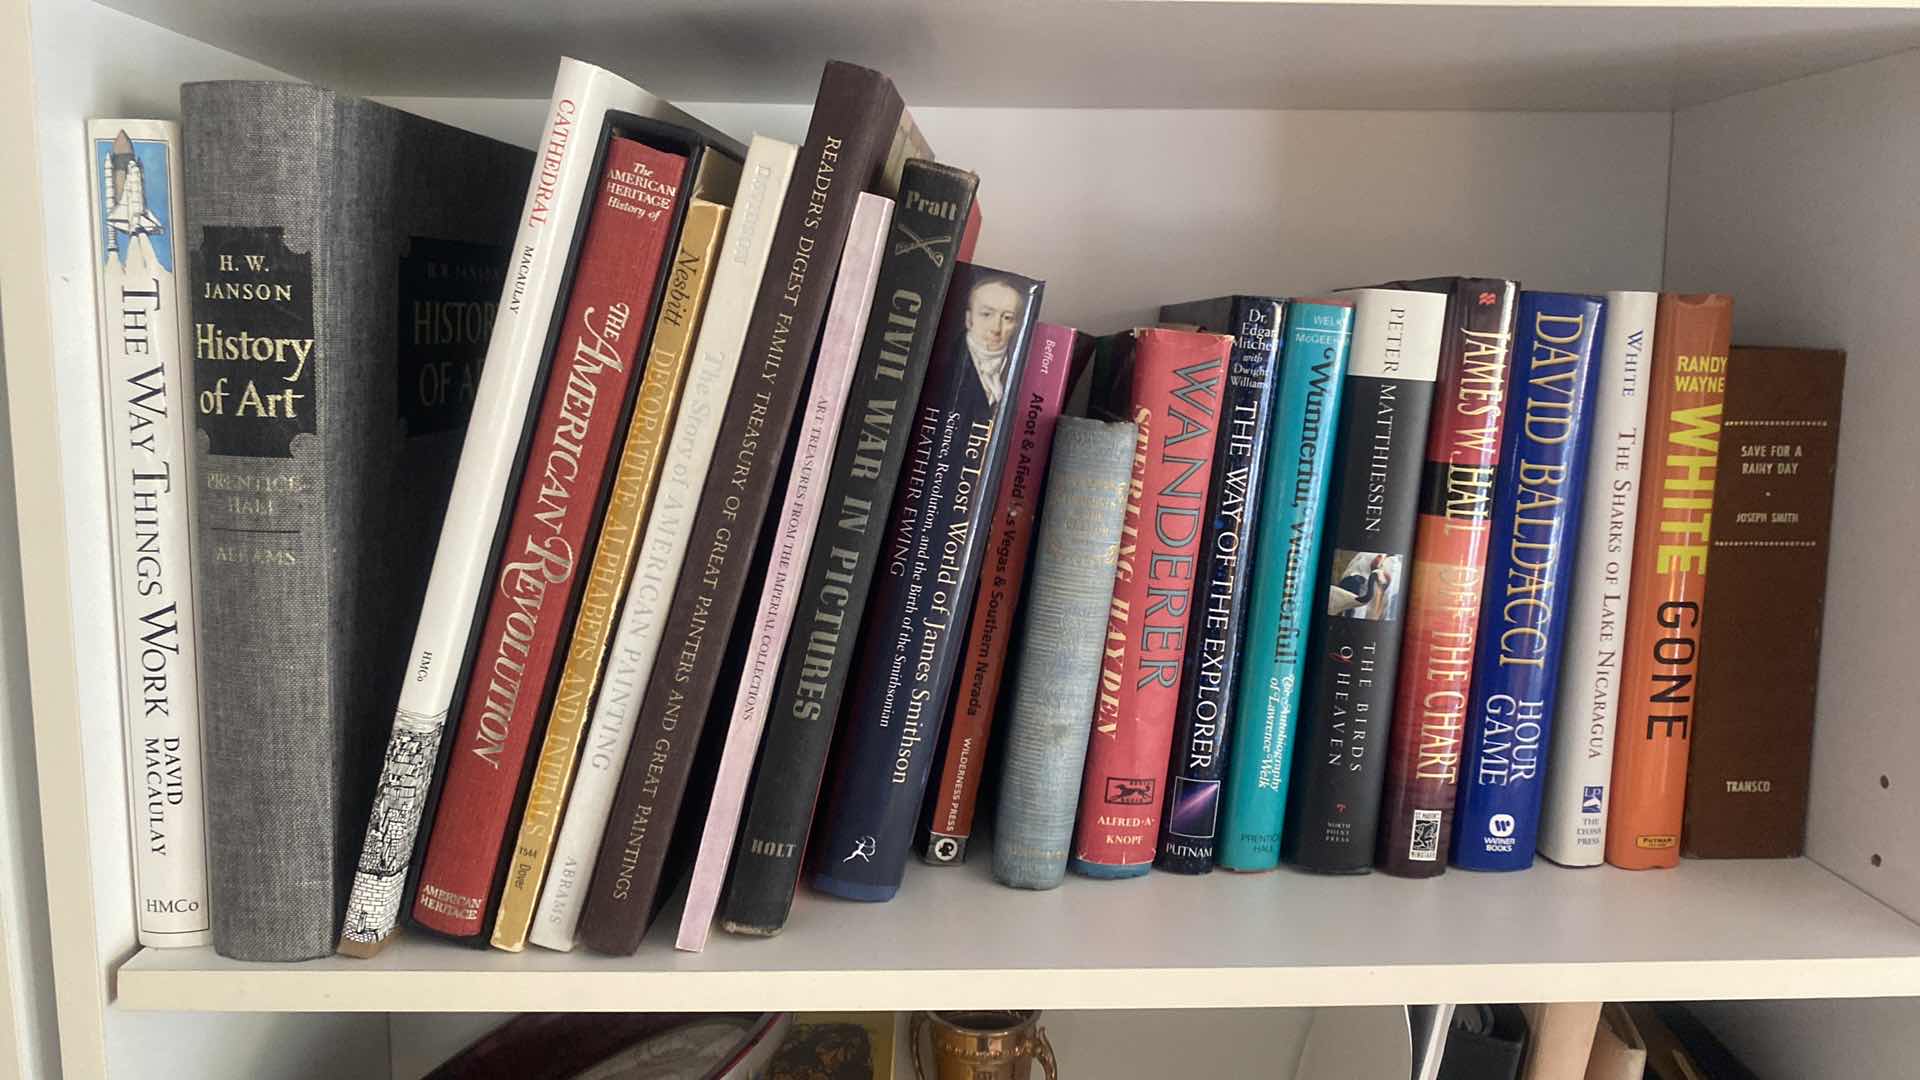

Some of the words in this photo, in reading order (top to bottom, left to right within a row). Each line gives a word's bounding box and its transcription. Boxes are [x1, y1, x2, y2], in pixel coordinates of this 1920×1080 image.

[527, 98, 576, 228] CATHEDRAL
[607, 168, 677, 198] AMERICAN
[632, 162, 655, 178] The
[804, 134, 843, 230] READER'S
[606, 182, 672, 210] HERITAGE
[607, 196, 646, 217] History
[647, 210, 663, 222] of
[904, 189, 960, 221] Pratt
[203, 283, 293, 302] JANSON
[218, 254, 240, 272] H.
[244, 255, 270, 273] W.
[509, 246, 535, 315] MACAULAY
[663, 249, 701, 328] Nesbitt
[783, 235, 816, 308] DIGEST
[121, 278, 161, 356] THE
[413, 301, 500, 345] HISTOR
[602, 301, 630, 343] THE
[874, 288, 923, 382] CIVIL
[1241, 321, 1277, 340] Edgar
[1249, 308, 1272, 324] Dr.
[1383, 308, 1406, 374] PETER
[195, 323, 315, 382] History
[760, 312, 793, 384] FAMILY
[1039, 338, 1057, 376] Beffort
[1456, 327, 1512, 417] JAMES
[1524, 311, 1585, 445] DAVID
[1622, 329, 1645, 398] WHITE
[1676, 355, 1729, 374] RANDY
[127, 362, 168, 453] WAY
[199, 377, 231, 415] of
[235, 379, 305, 419] Art
[815, 394, 829, 423] ART
[1023, 392, 1044, 436] Afoot
[1674, 375, 1726, 393] WAYNE
[532, 305, 625, 535] AMERICAN
[614, 348, 676, 512] DECORATIVE
[731, 391, 773, 491] TREASURY
[850, 399, 898, 481] WAR
[938, 411, 962, 460] Science,
[965, 418, 994, 460] The
[1021, 437, 1035, 452] &
[1229, 400, 1258, 458] THE
[1615, 426, 1637, 472] THE
[797, 424, 821, 502] TREASURES
[906, 406, 941, 499] HEATHER
[1011, 454, 1031, 499] Afield
[1364, 383, 1397, 533] MATTHIESSEN
[1741, 445, 1768, 458] SAVE
[1771, 445, 1791, 457] FOR
[1794, 445, 1803, 457] A
[1742, 463, 1774, 475] RAINY
[1777, 463, 1799, 475] DAY
[722, 495, 741, 521] OF
[837, 495, 873, 536] IN
[922, 462, 950, 533] Revolution,
[953, 465, 982, 514] Lost
[1221, 467, 1250, 523] WAY
[1443, 461, 1496, 536] HALL
[1607, 479, 1632, 554] SHARKS
[1656, 402, 1724, 576] WHITE
[1736, 512, 1768, 523] JOSEPH
[1771, 512, 1799, 523] SMITH
[131, 460, 171, 597] THINGS
[786, 502, 805, 541] FROM
[889, 505, 918, 578] EWING
[916, 534, 931, 560] and
[996, 528, 1017, 575] Vegas
[1136, 355, 1223, 692] WANDERER
[1215, 531, 1240, 568] OF
[631, 495, 684, 639] AMERICAN
[703, 526, 732, 591] GREAT
[778, 542, 794, 569] THE
[910, 560, 928, 583] the
[937, 520, 970, 586] World
[993, 576, 1008, 589] &
[1499, 458, 1569, 671] BALDACCI
[1605, 561, 1621, 586] OF
[575, 521, 629, 662] ALPHABETS
[766, 568, 788, 634] IMPERIAL
[906, 584, 923, 614] Birth
[931, 590, 951, 617] of
[1206, 575, 1234, 631] THE
[1600, 592, 1621, 643] LAKE
[471, 533, 574, 770] REVOLUTION
[674, 594, 713, 684] PAINTERS
[792, 544, 860, 722] PICTURES
[897, 632, 913, 653] the
[901, 615, 914, 633] of
[915, 616, 946, 683] James
[980, 590, 1004, 660] Southern
[1426, 626, 1474, 681] THE
[138, 600, 180, 718] WORK
[743, 634, 771, 722] COLLECTIONS
[967, 661, 990, 717] Nevada
[1097, 597, 1131, 740] HAYDEN
[1358, 639, 1377, 689] THE
[1646, 600, 1699, 741] GONE
[556, 666, 587, 724] AND
[591, 647, 642, 771] PAINTING
[662, 688, 685, 732] AND
[879, 653, 905, 729] Smithsonian
[1188, 637, 1226, 769] EXPLORER
[1327, 671, 1351, 767] HEAVEN
[1589, 650, 1617, 760] NICARAGUA
[891, 687, 932, 785] Smithson
[1263, 694, 1280, 754] Lawrence
[1269, 700, 1293, 792] Autobiography
[1350, 702, 1370, 773] BIRDS
[1415, 691, 1467, 785] CHART
[1478, 693, 1518, 787] GAME
[1509, 699, 1544, 783] HOUR
[144, 738, 167, 857] MACAULAY
[163, 737, 184, 806] DAVID
[526, 735, 571, 838] INITIALS
[641, 738, 671, 798] GREAT
[953, 736, 973, 802] WILDERNESS
[1257, 754, 1274, 789] Welk
[1726, 780, 1772, 793] TRANSCO
[945, 802, 960, 833] PRESS
[1106, 834, 1145, 845] KNOPF
[612, 804, 653, 901] PAINTINGS
[751, 838, 798, 860] HOLT
[1165, 843, 1213, 858] PUTNAM
[1486, 844, 1512, 852] BOOKS
[146, 898, 200, 913] HMCo
[420, 896, 479, 921] HERITAGE
[423, 884, 483, 909] AMERICAN
[550, 856, 577, 925] ABRAMS
